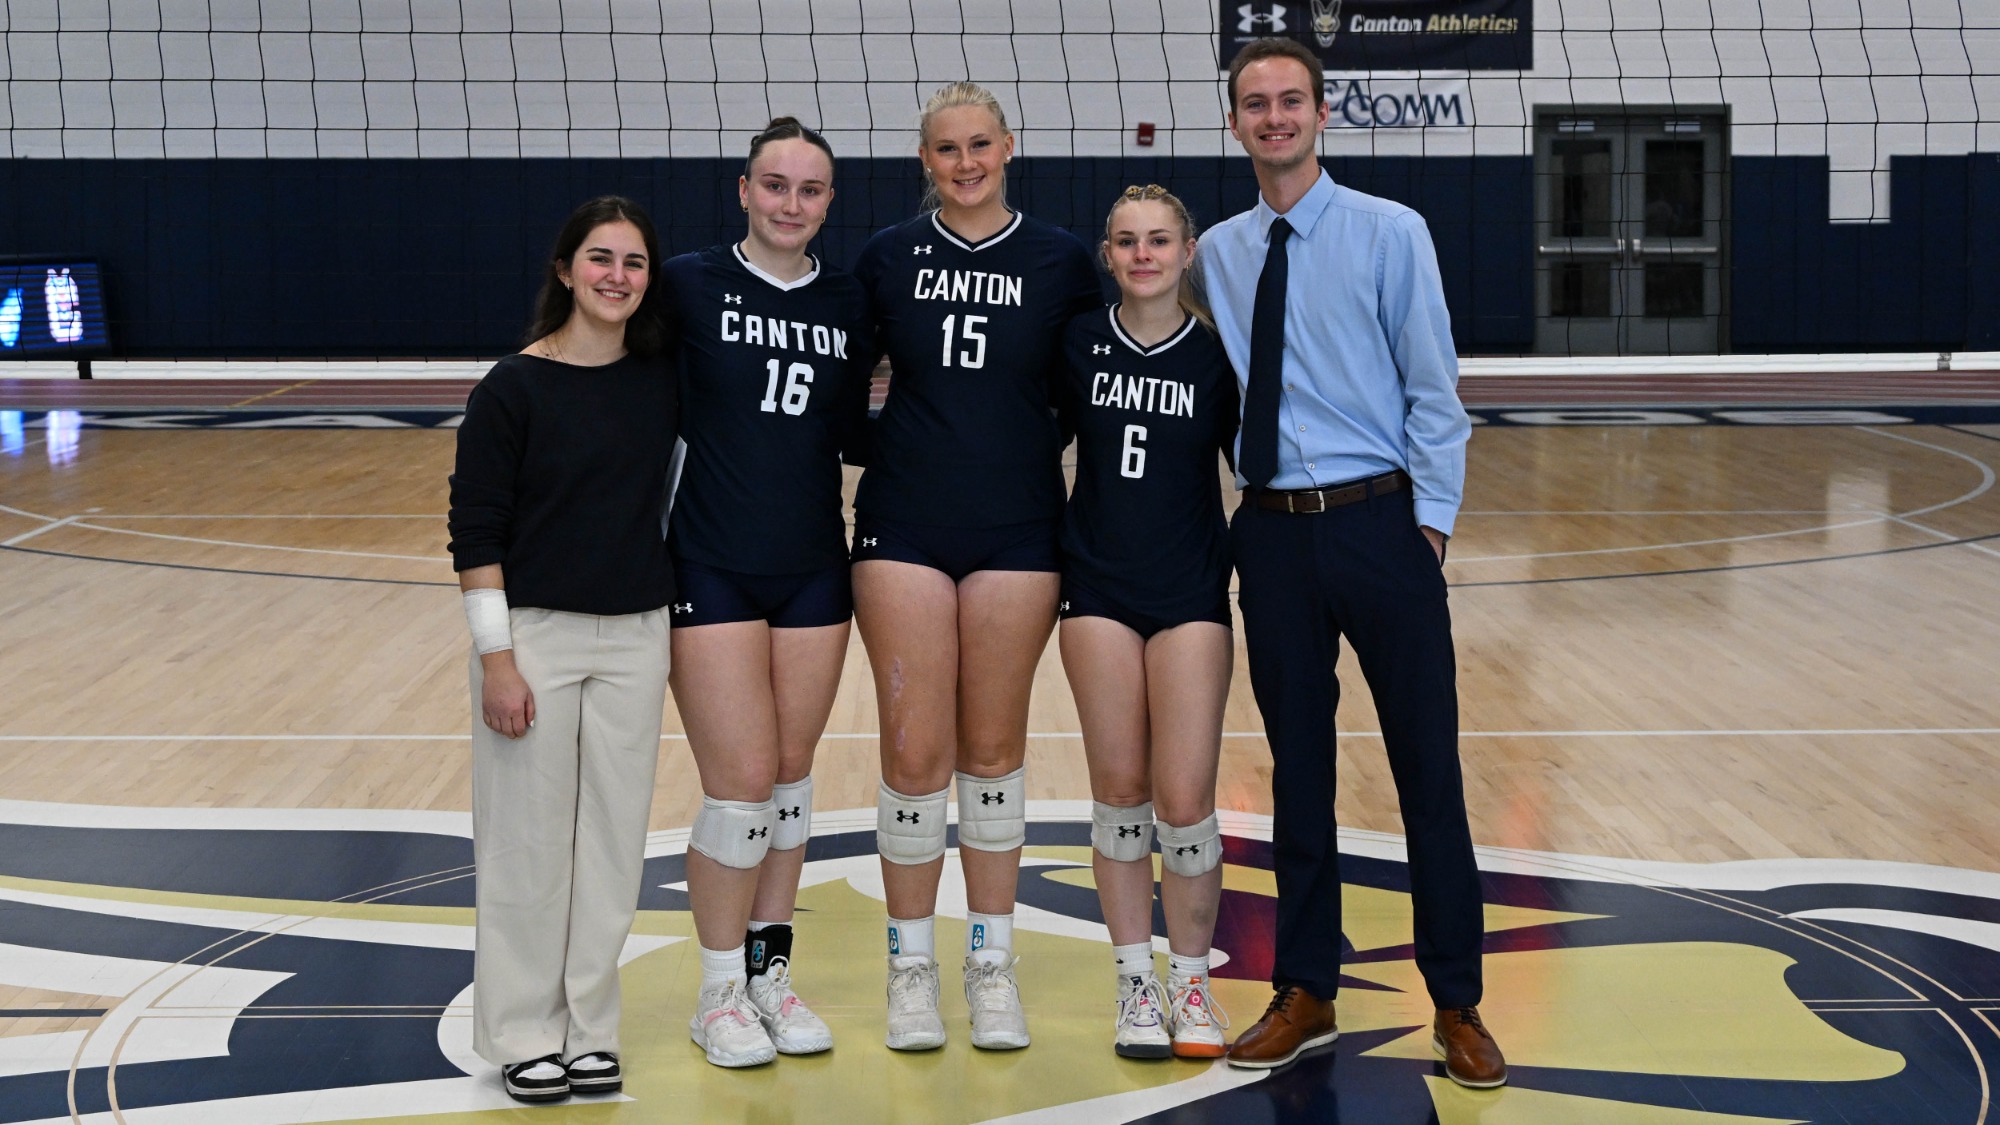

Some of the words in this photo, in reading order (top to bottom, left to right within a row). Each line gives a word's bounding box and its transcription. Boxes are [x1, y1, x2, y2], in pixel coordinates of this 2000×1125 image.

[1350, 14, 1422, 33] Canton
[1426, 13, 1518, 33] Athletics
[914, 268, 1023, 307] CANTON
[721, 310, 848, 360] CANTON
[942, 314, 988, 369] 15
[760, 358, 814, 416] 16
[1091, 372, 1195, 419] CANTON
[1120, 424, 1148, 479] 6
